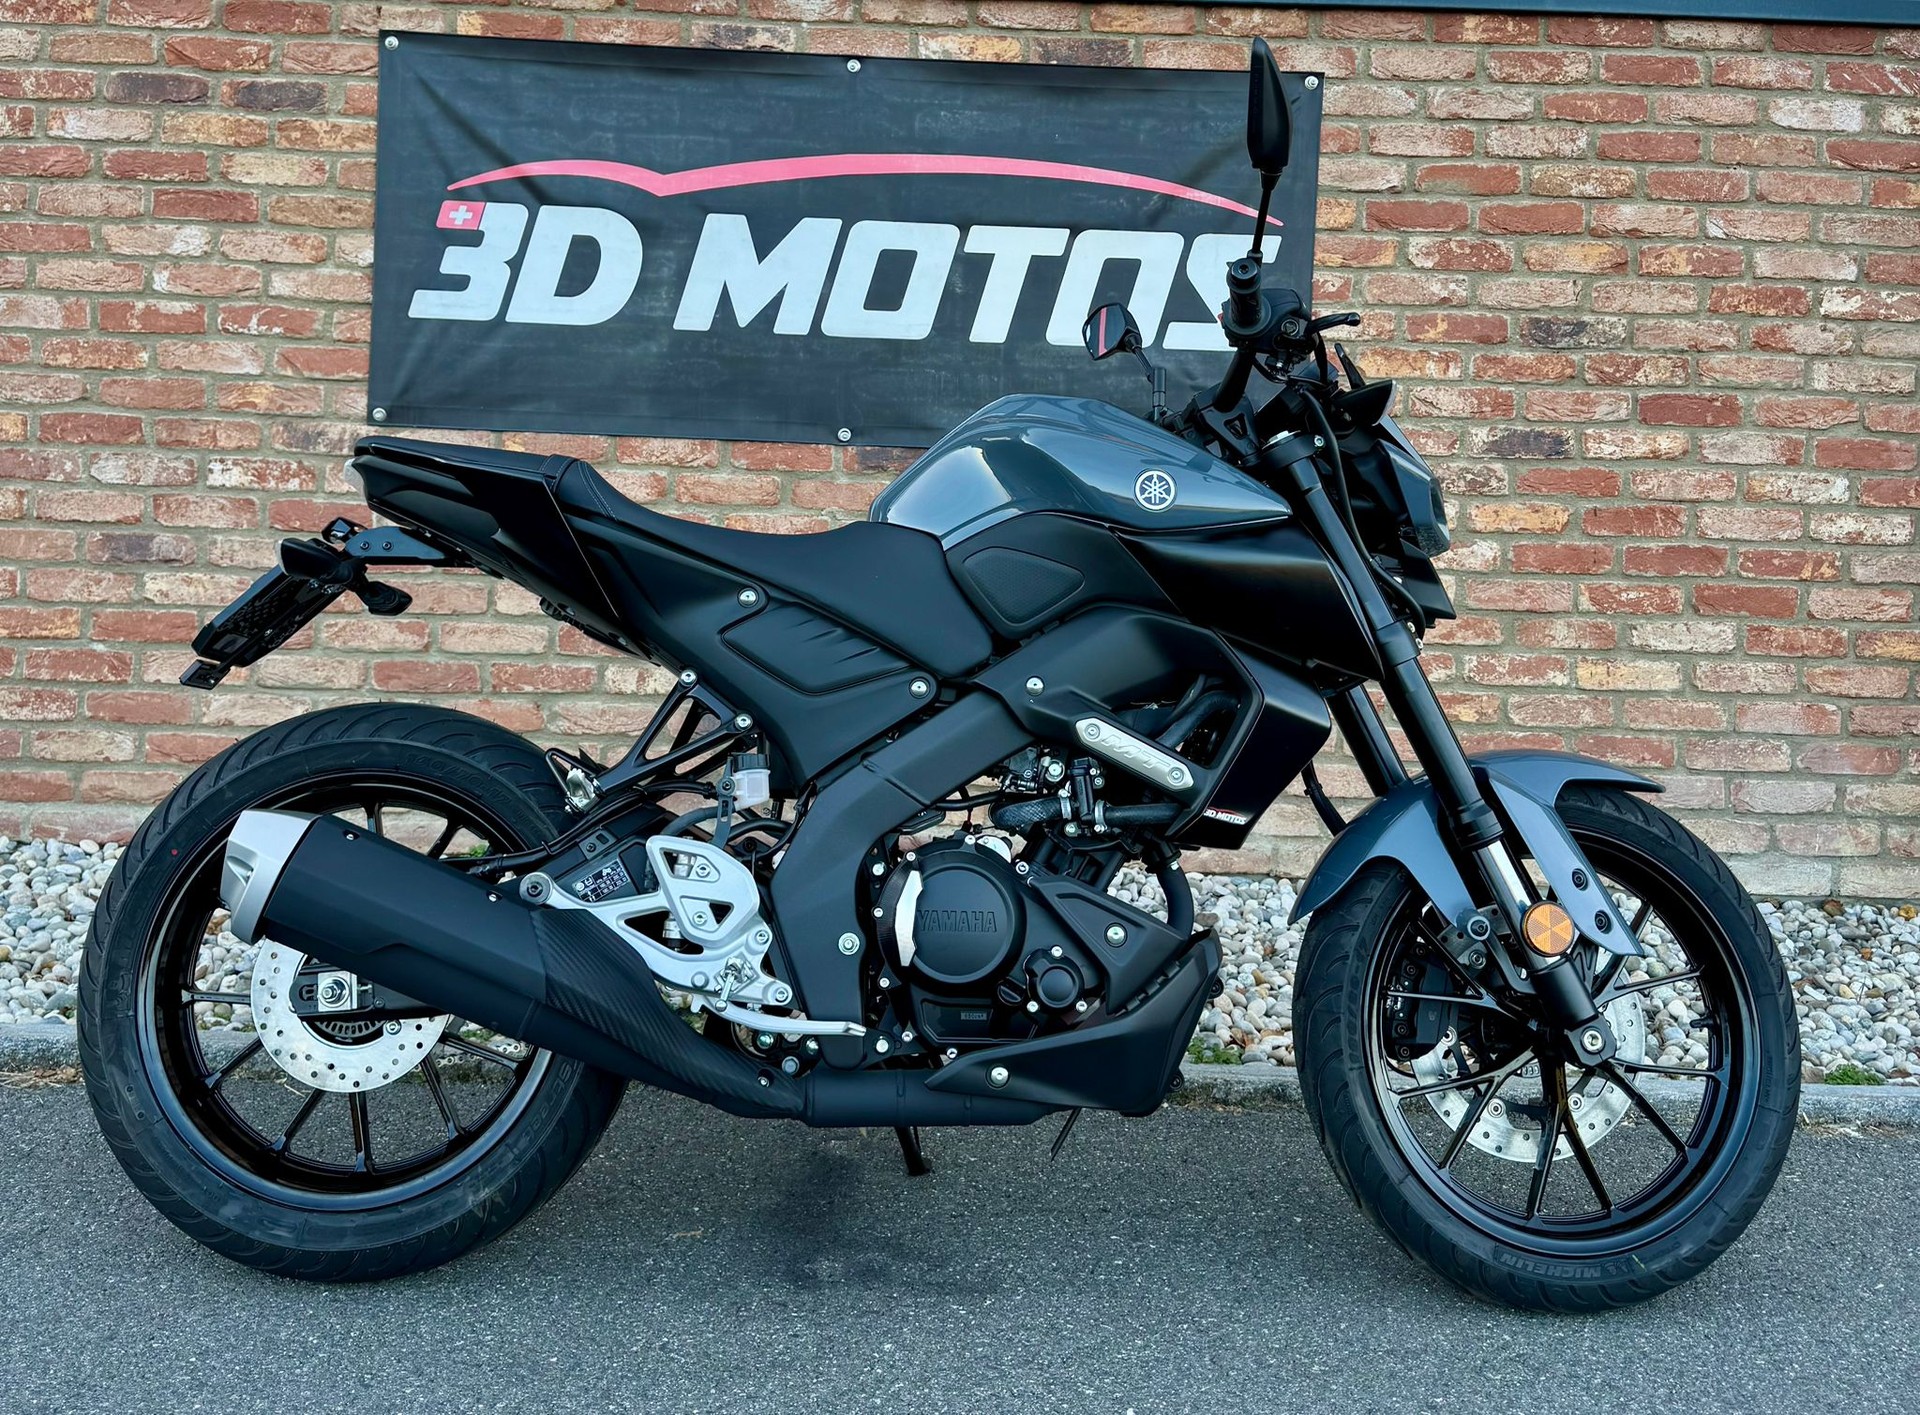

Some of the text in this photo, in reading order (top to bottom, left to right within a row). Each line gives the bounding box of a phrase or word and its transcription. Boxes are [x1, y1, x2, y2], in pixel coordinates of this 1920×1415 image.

[408, 201, 1282, 351] 3D MOTOS
[1101, 733, 1171, 769] MT
[1203, 808, 1248, 825] 3D MOTOS
[916, 909, 998, 933] YAMAHA
[1498, 1252, 1602, 1280] MICHELIN
